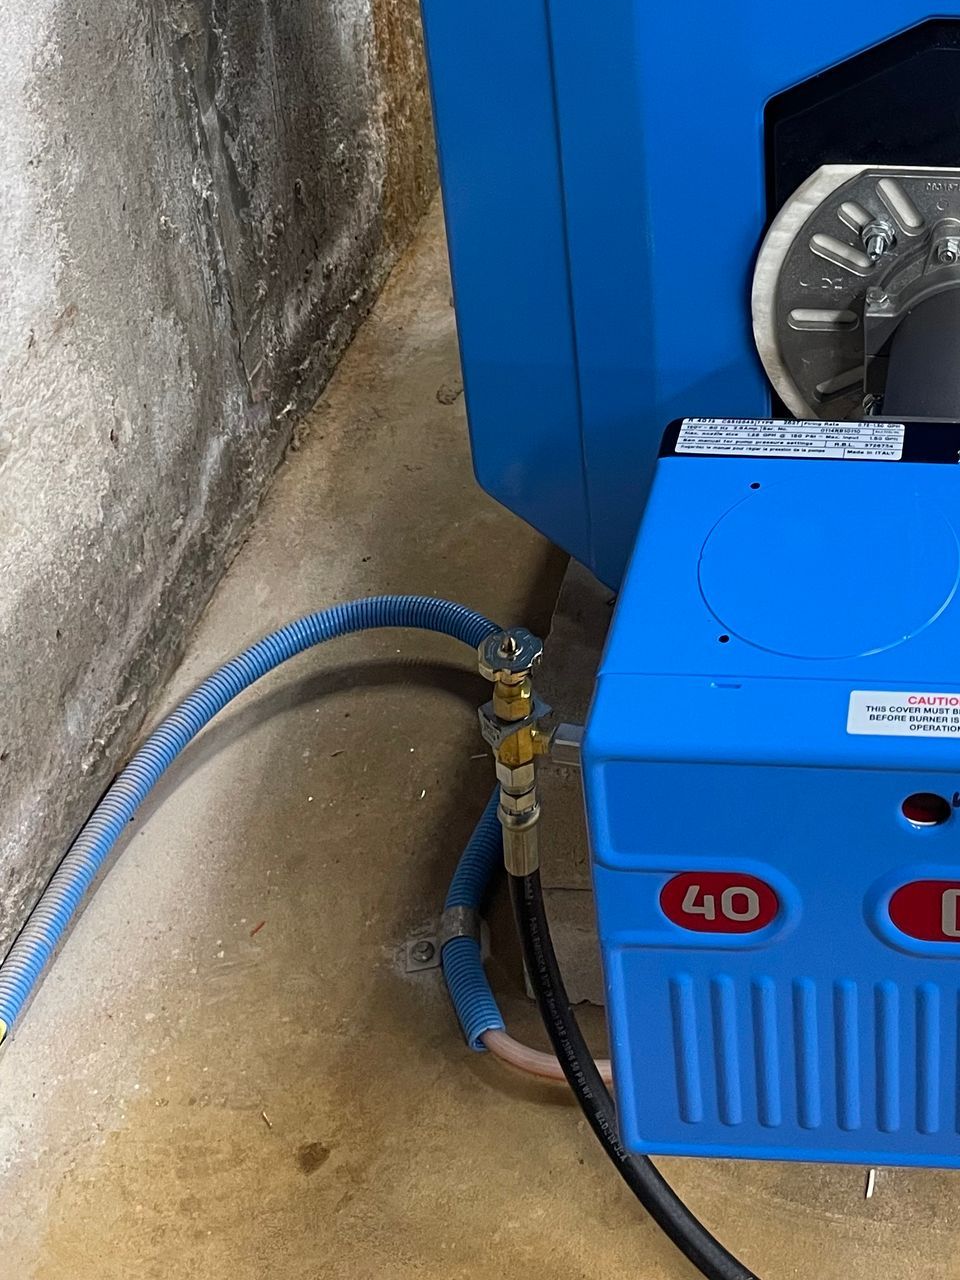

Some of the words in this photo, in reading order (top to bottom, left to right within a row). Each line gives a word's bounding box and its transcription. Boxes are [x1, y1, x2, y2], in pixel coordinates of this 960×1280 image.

[681, 885, 760, 922] 40
[581, 1085, 593, 1100] WP
[594, 1111, 612, 1135] MADE
